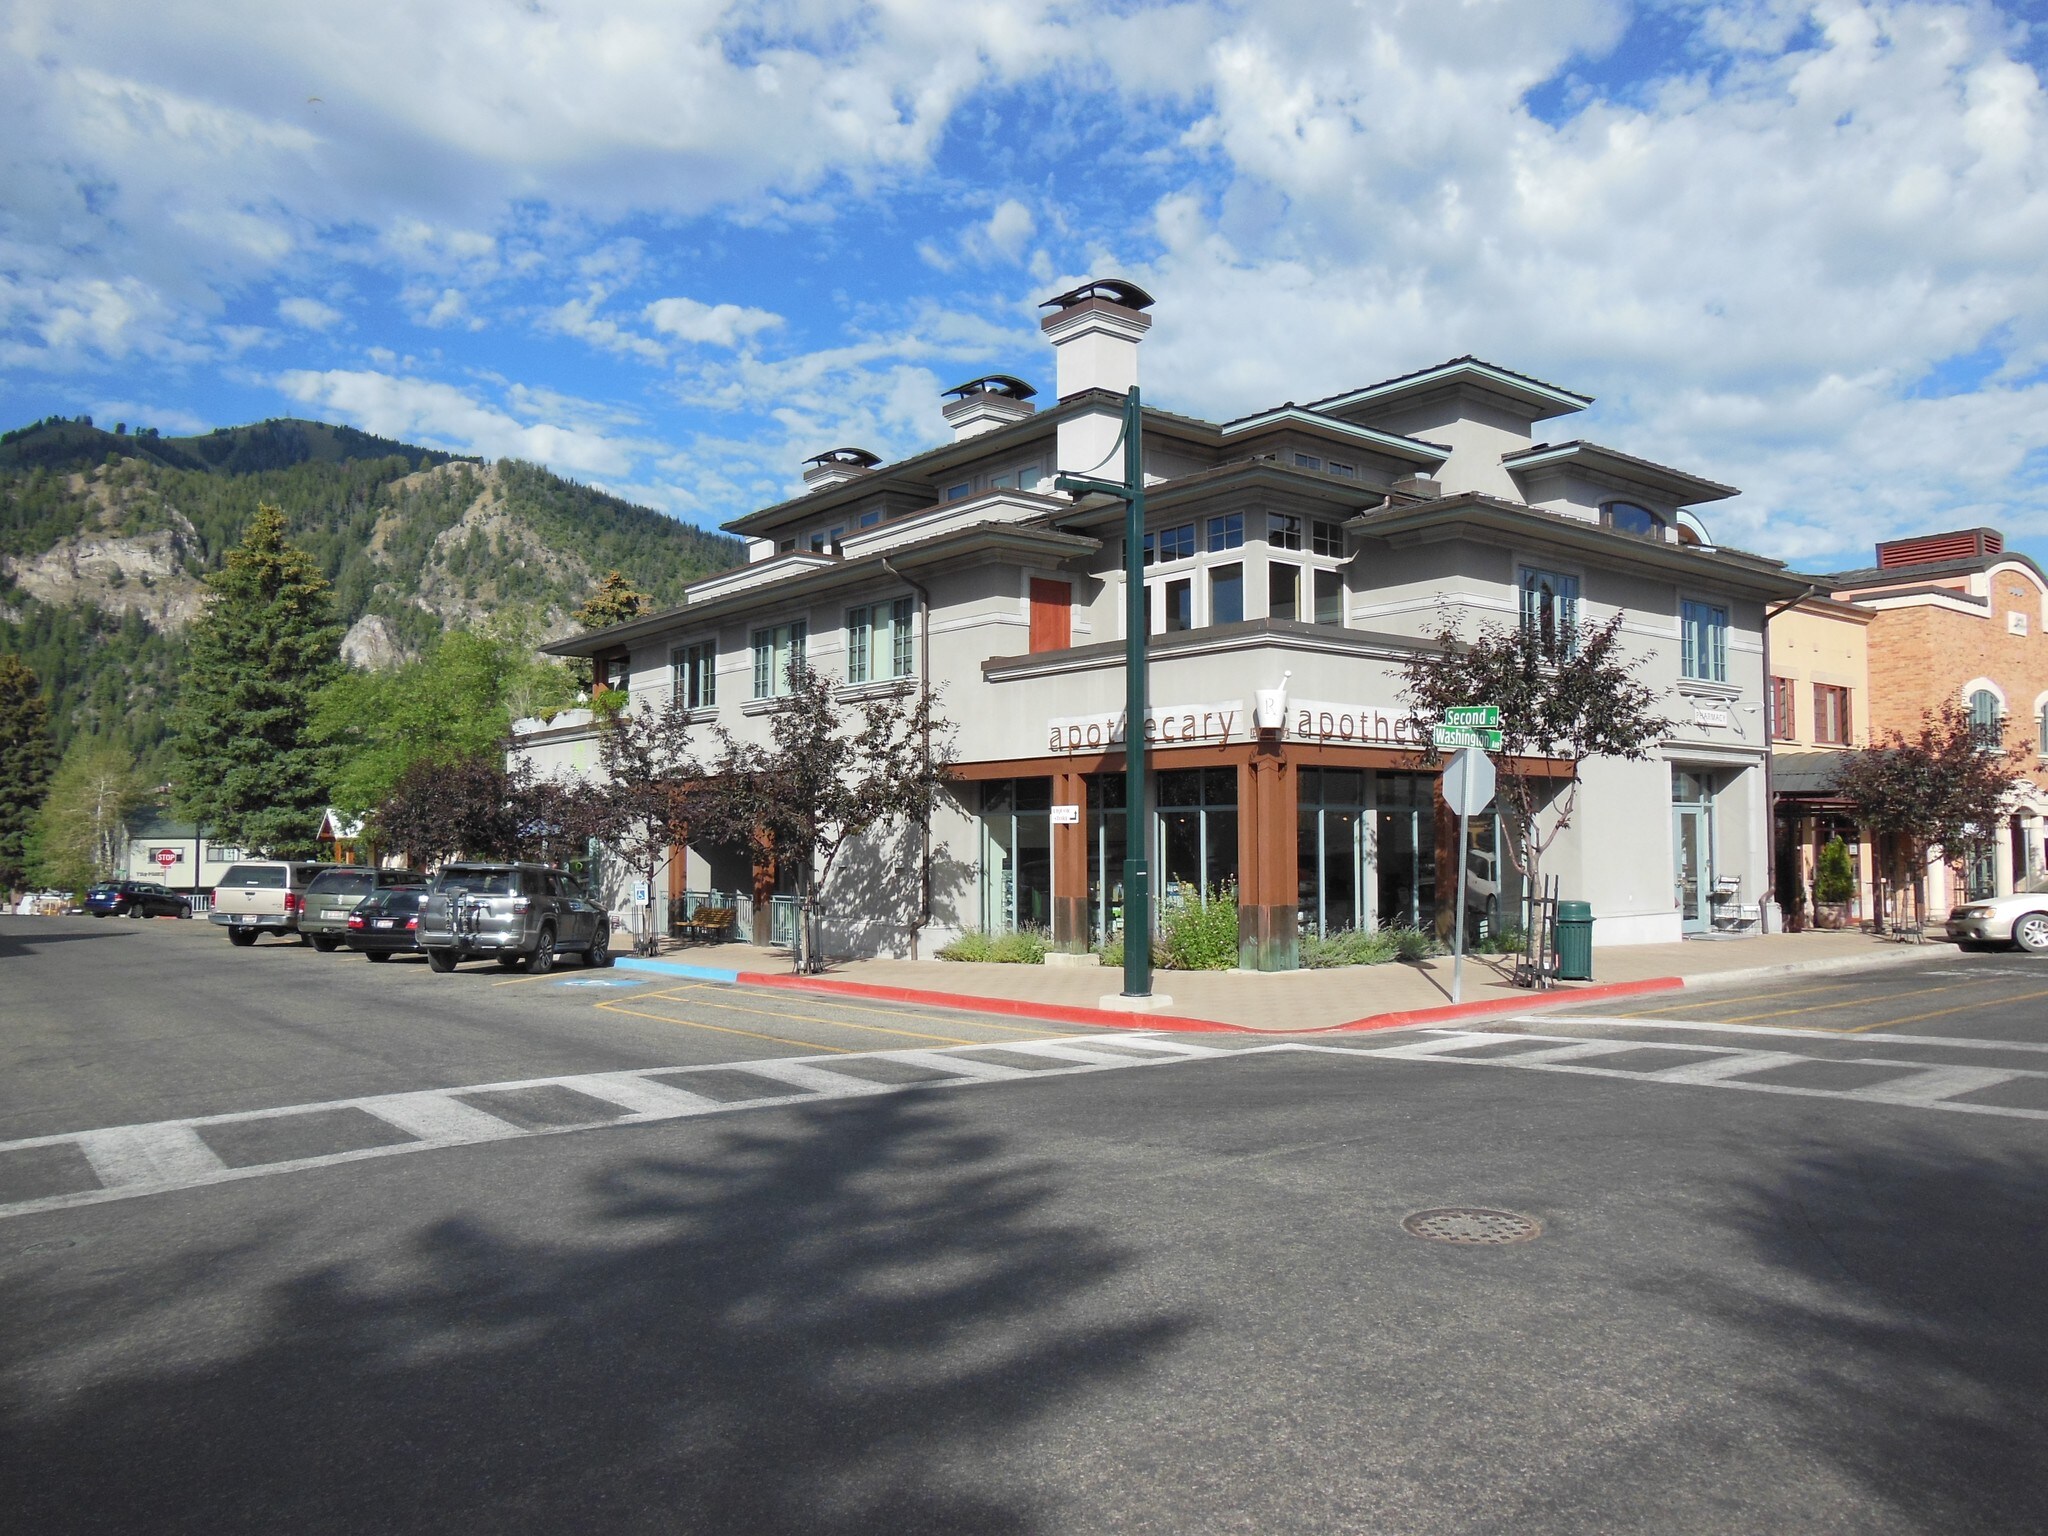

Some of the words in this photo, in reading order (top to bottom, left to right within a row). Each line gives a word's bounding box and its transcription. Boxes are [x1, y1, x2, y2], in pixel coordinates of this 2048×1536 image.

[1447, 708, 1486, 726] Second
[1435, 727, 1490, 748] Washington
[1491, 740, 1500, 749] Ave
